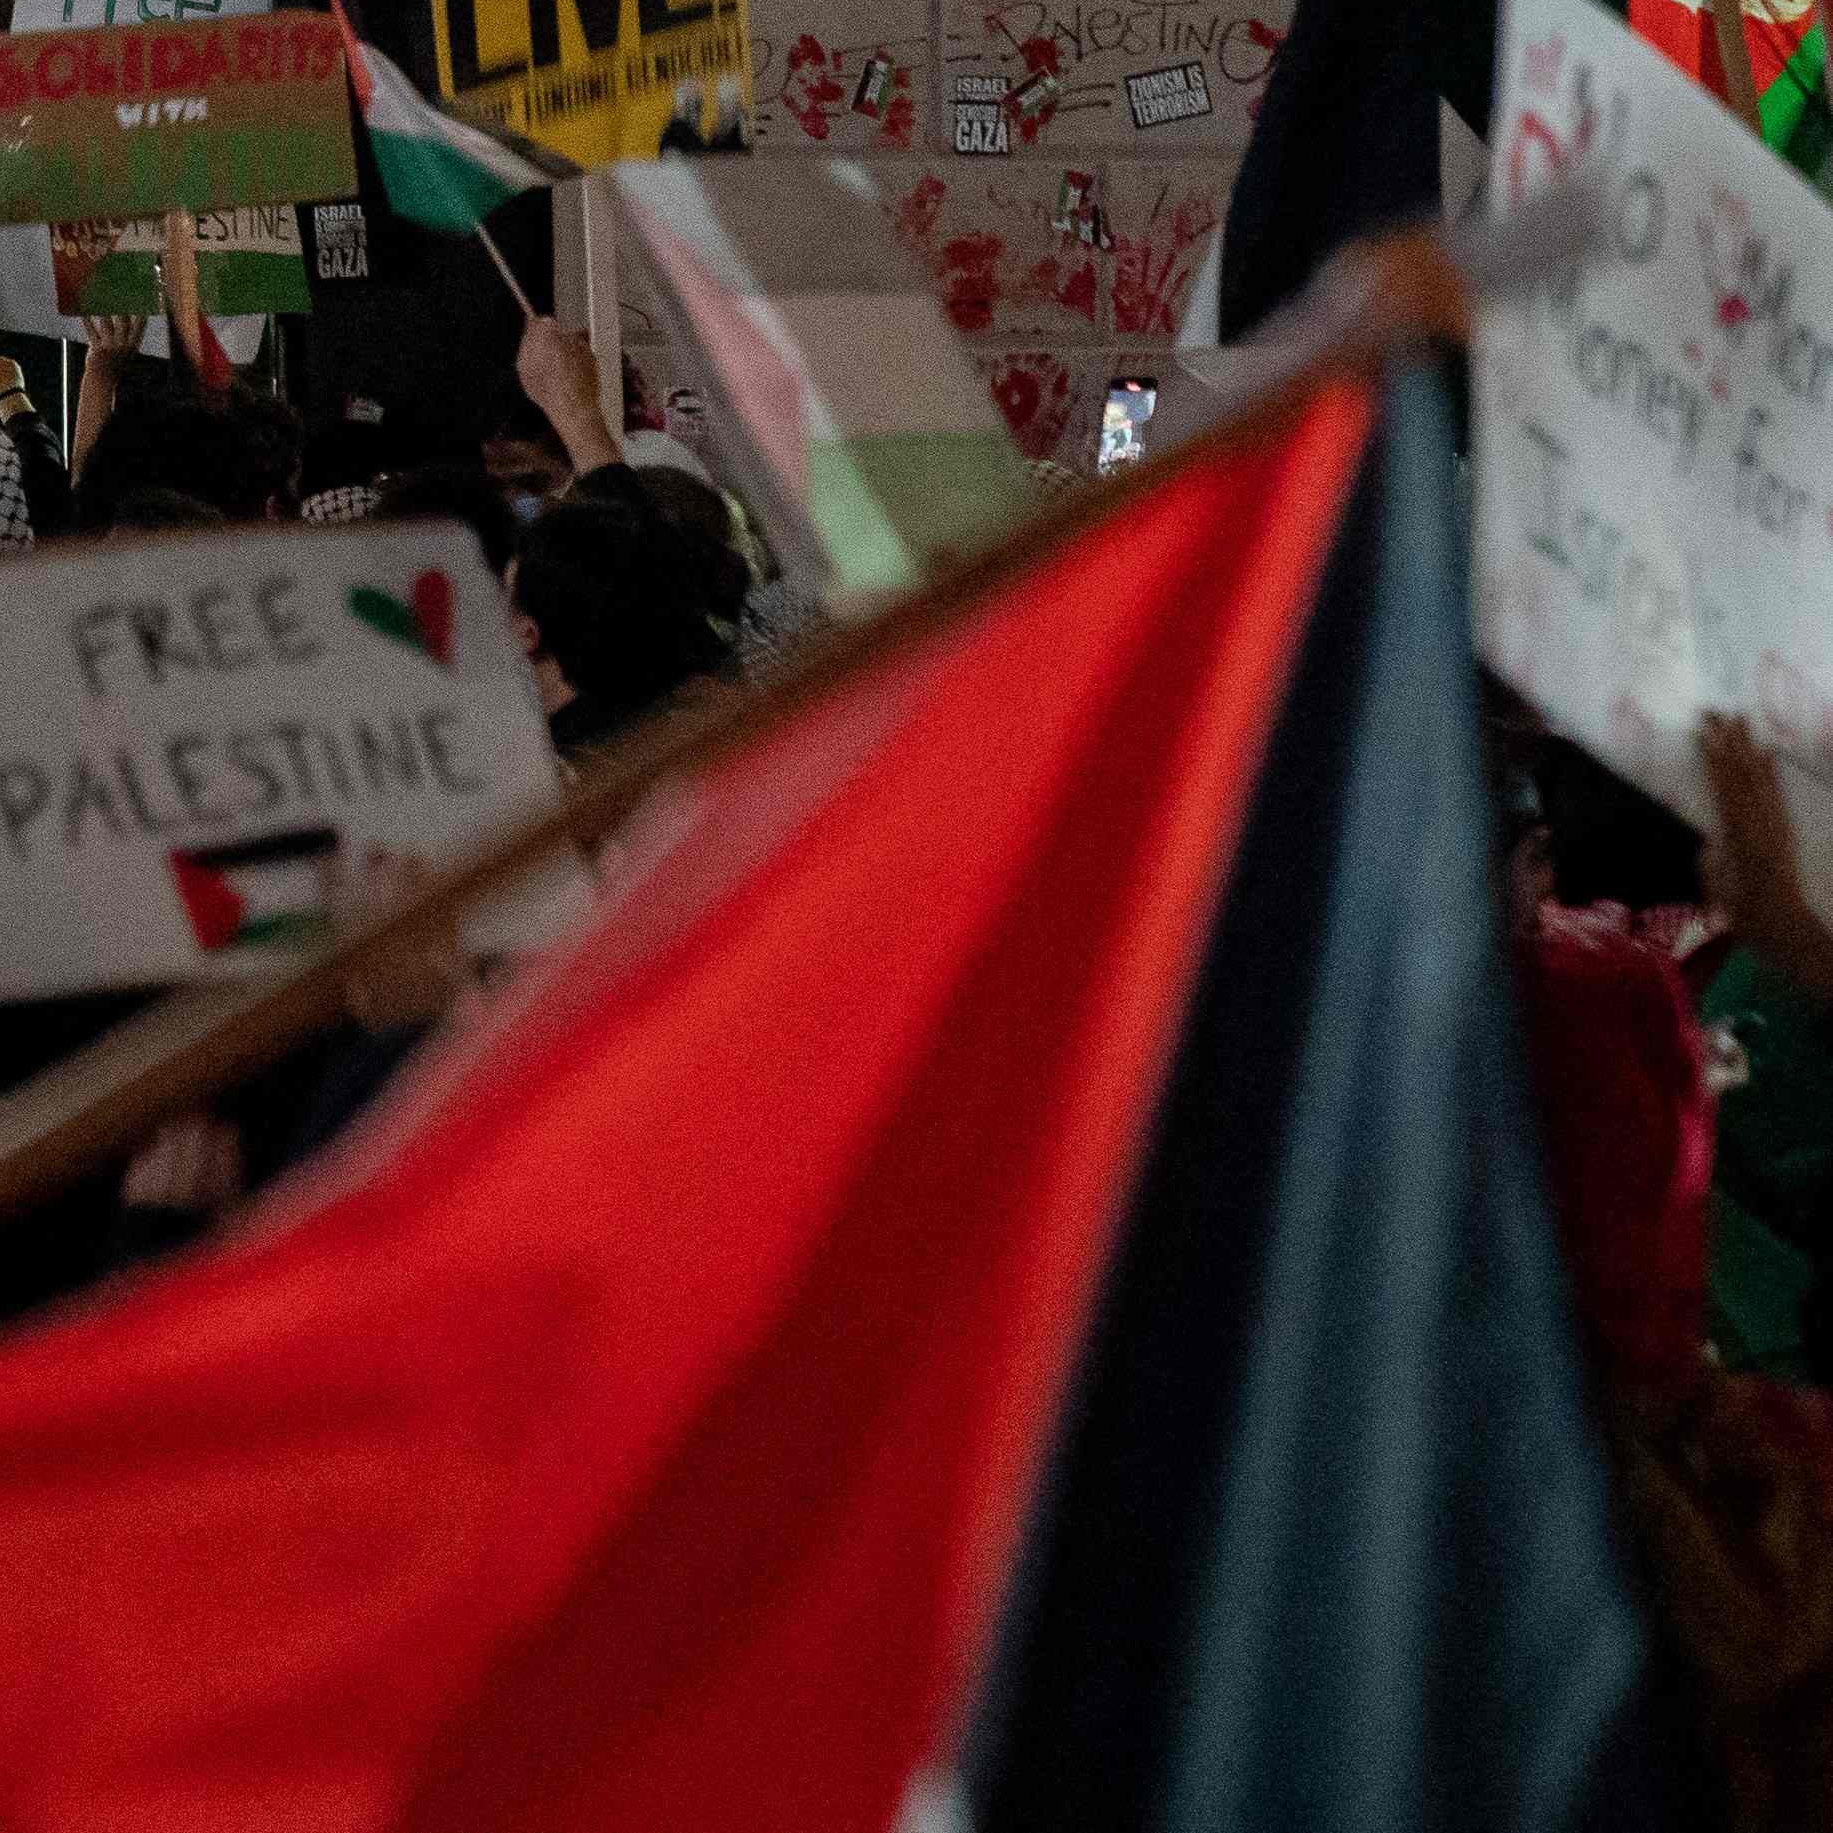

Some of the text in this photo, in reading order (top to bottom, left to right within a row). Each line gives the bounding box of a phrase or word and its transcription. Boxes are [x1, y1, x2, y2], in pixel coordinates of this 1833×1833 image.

[957, 77, 1009, 94] ISRAEL
[1129, 63, 1204, 101] ZIONISM IS
[1134, 89, 1212, 129] TERRORISM
[955, 119, 1009, 153] GAZA
[317, 248, 370, 280] GAZA
[72, 572, 328, 699] FREE
